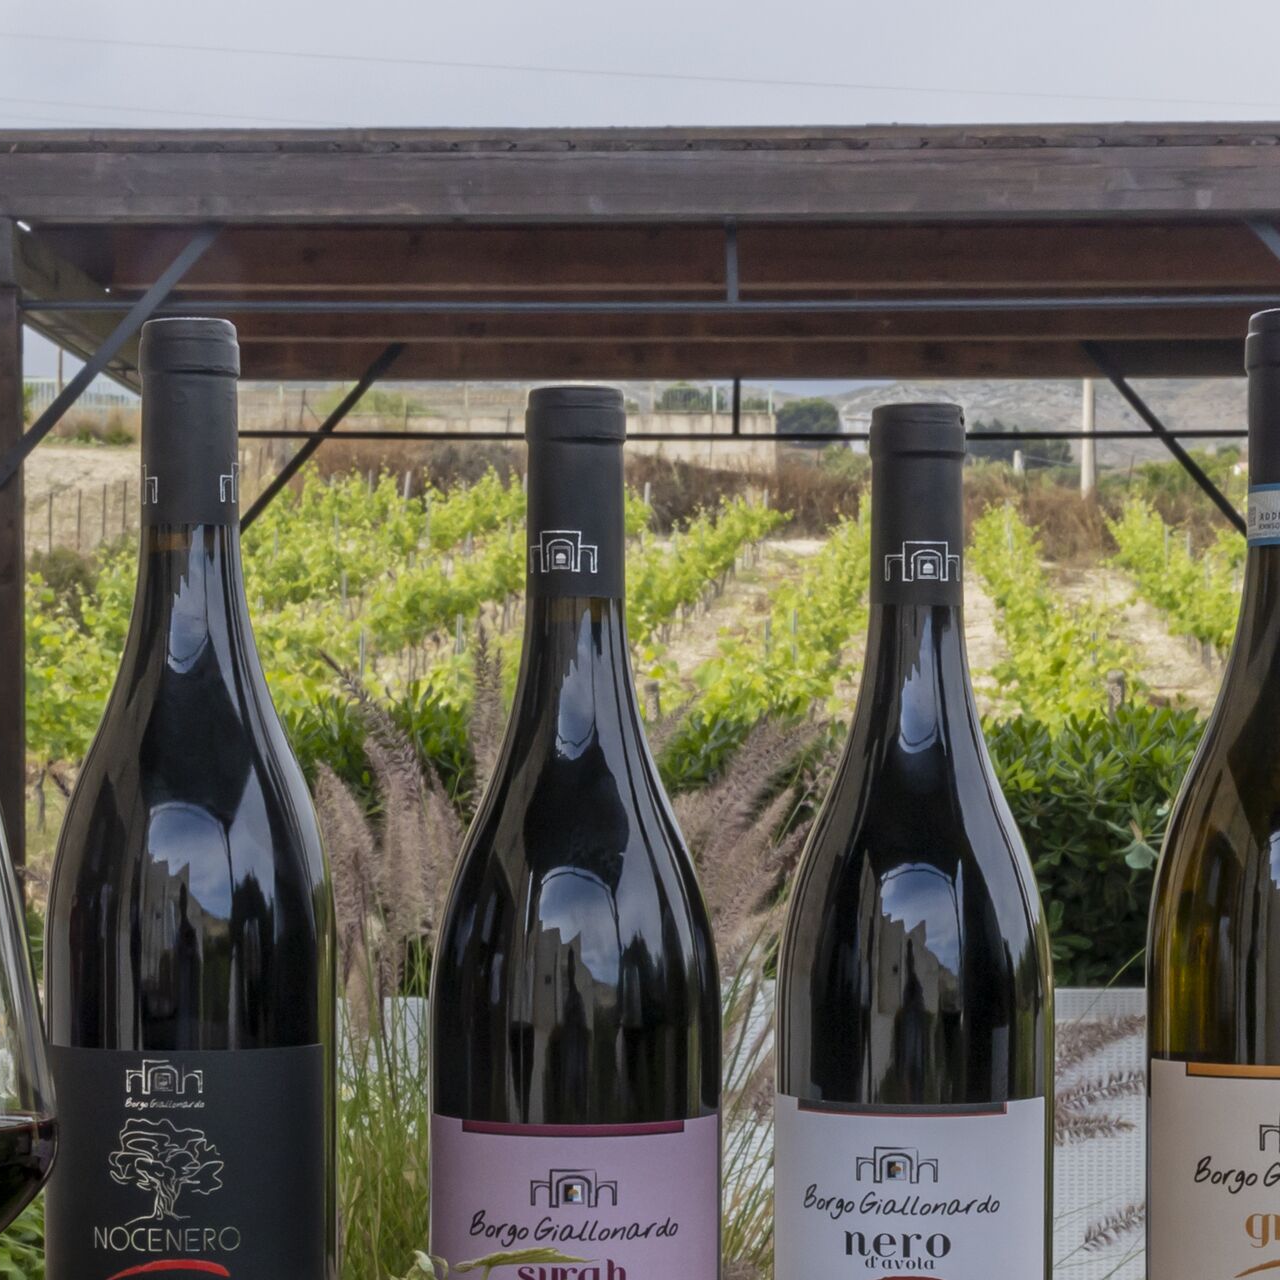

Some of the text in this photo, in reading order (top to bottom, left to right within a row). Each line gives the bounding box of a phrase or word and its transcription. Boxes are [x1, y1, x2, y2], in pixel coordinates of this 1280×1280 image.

[124, 1096, 206, 1111] Borgo Giallonardo
[1193, 1155, 1258, 1194] Borgo
[803, 1183, 1001, 1220] Borgo Giallonardo
[93, 1226, 241, 1252] NOCENERO
[469, 1209, 679, 1247] Borgo Giallonardo
[844, 1230, 952, 1259] nero
[864, 1255, 936, 1271] d'avola
